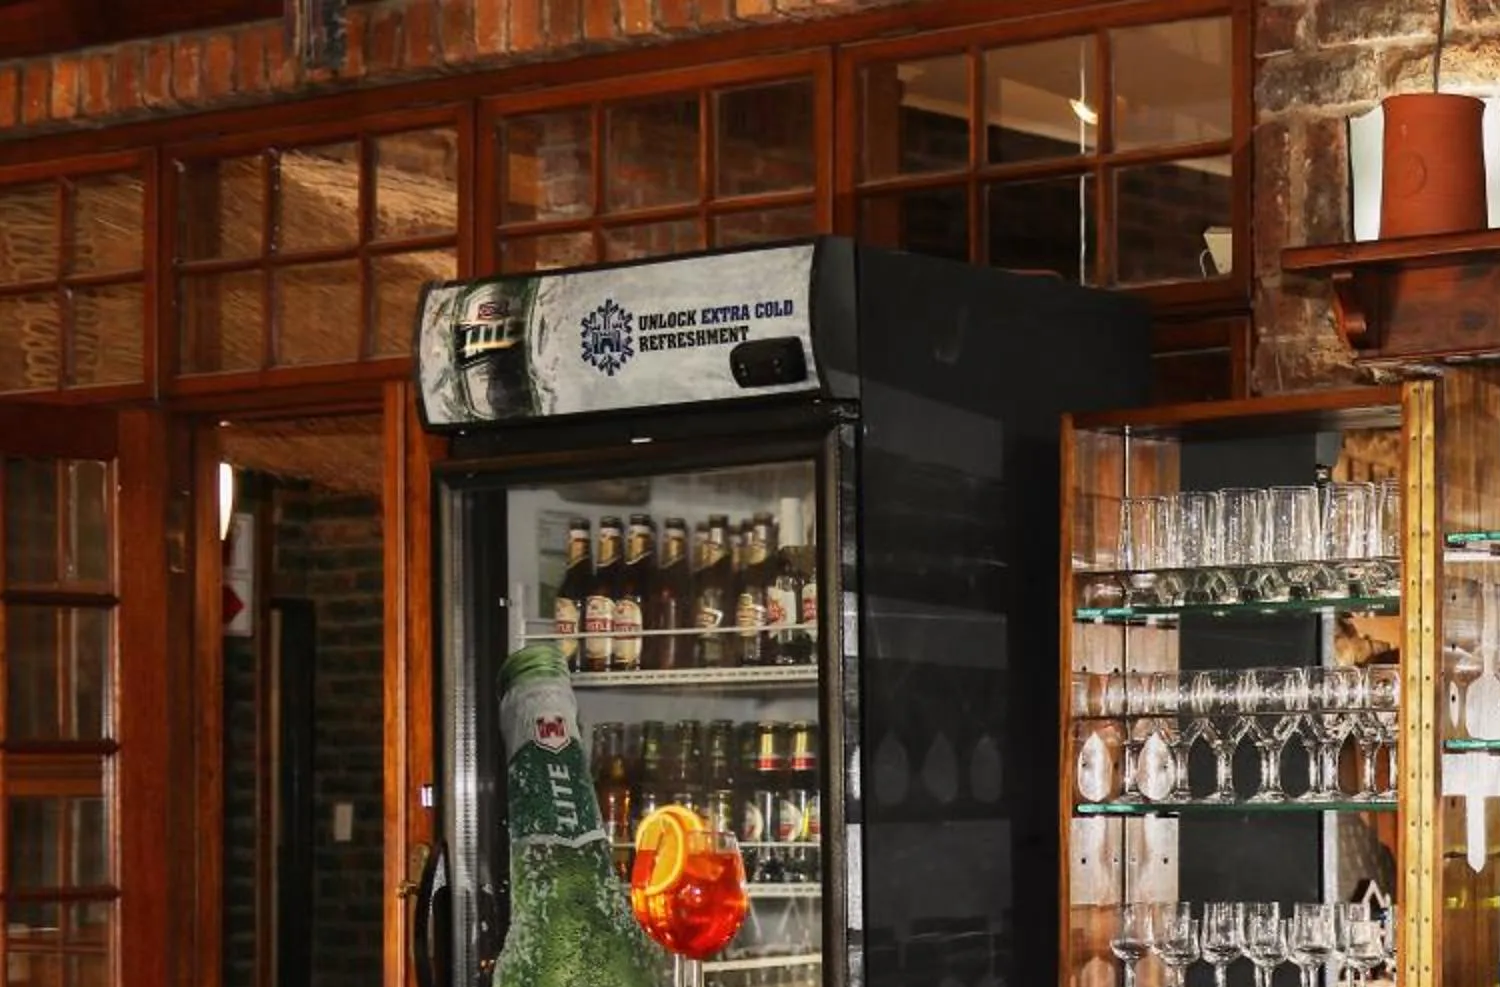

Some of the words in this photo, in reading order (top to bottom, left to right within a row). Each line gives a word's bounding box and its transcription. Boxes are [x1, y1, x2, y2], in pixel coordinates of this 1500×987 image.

[639, 310, 697, 331] UNLOCK
[701, 304, 750, 325] EXTRA
[755, 299, 794, 319] COLD
[639, 325, 749, 352] REFRESHMENT
[547, 762, 579, 827] LITE
